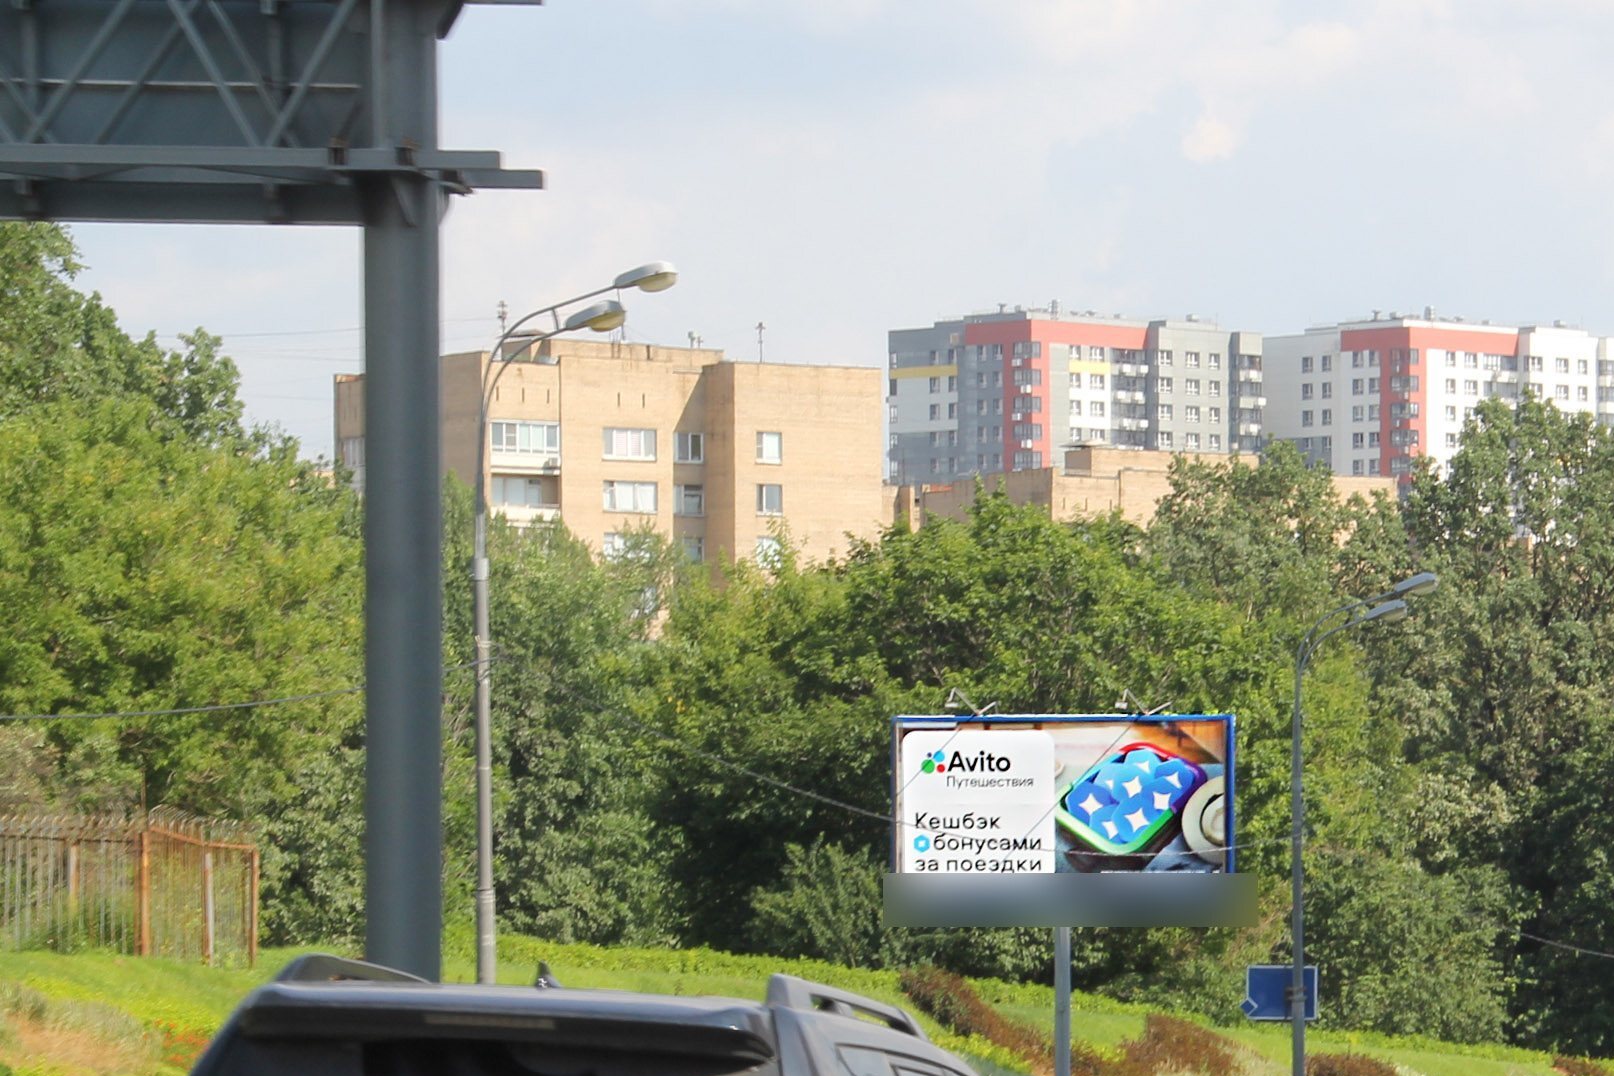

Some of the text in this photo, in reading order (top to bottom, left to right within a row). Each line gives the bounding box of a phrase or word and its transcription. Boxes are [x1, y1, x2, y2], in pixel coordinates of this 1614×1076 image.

[947, 750, 1011, 772] Avito
[946, 775, 1034, 789] Путешествия
[914, 812, 1001, 829] Кешбэк
[933, 832, 1042, 855] бонусами
[915, 859, 1042, 873] за поездки
